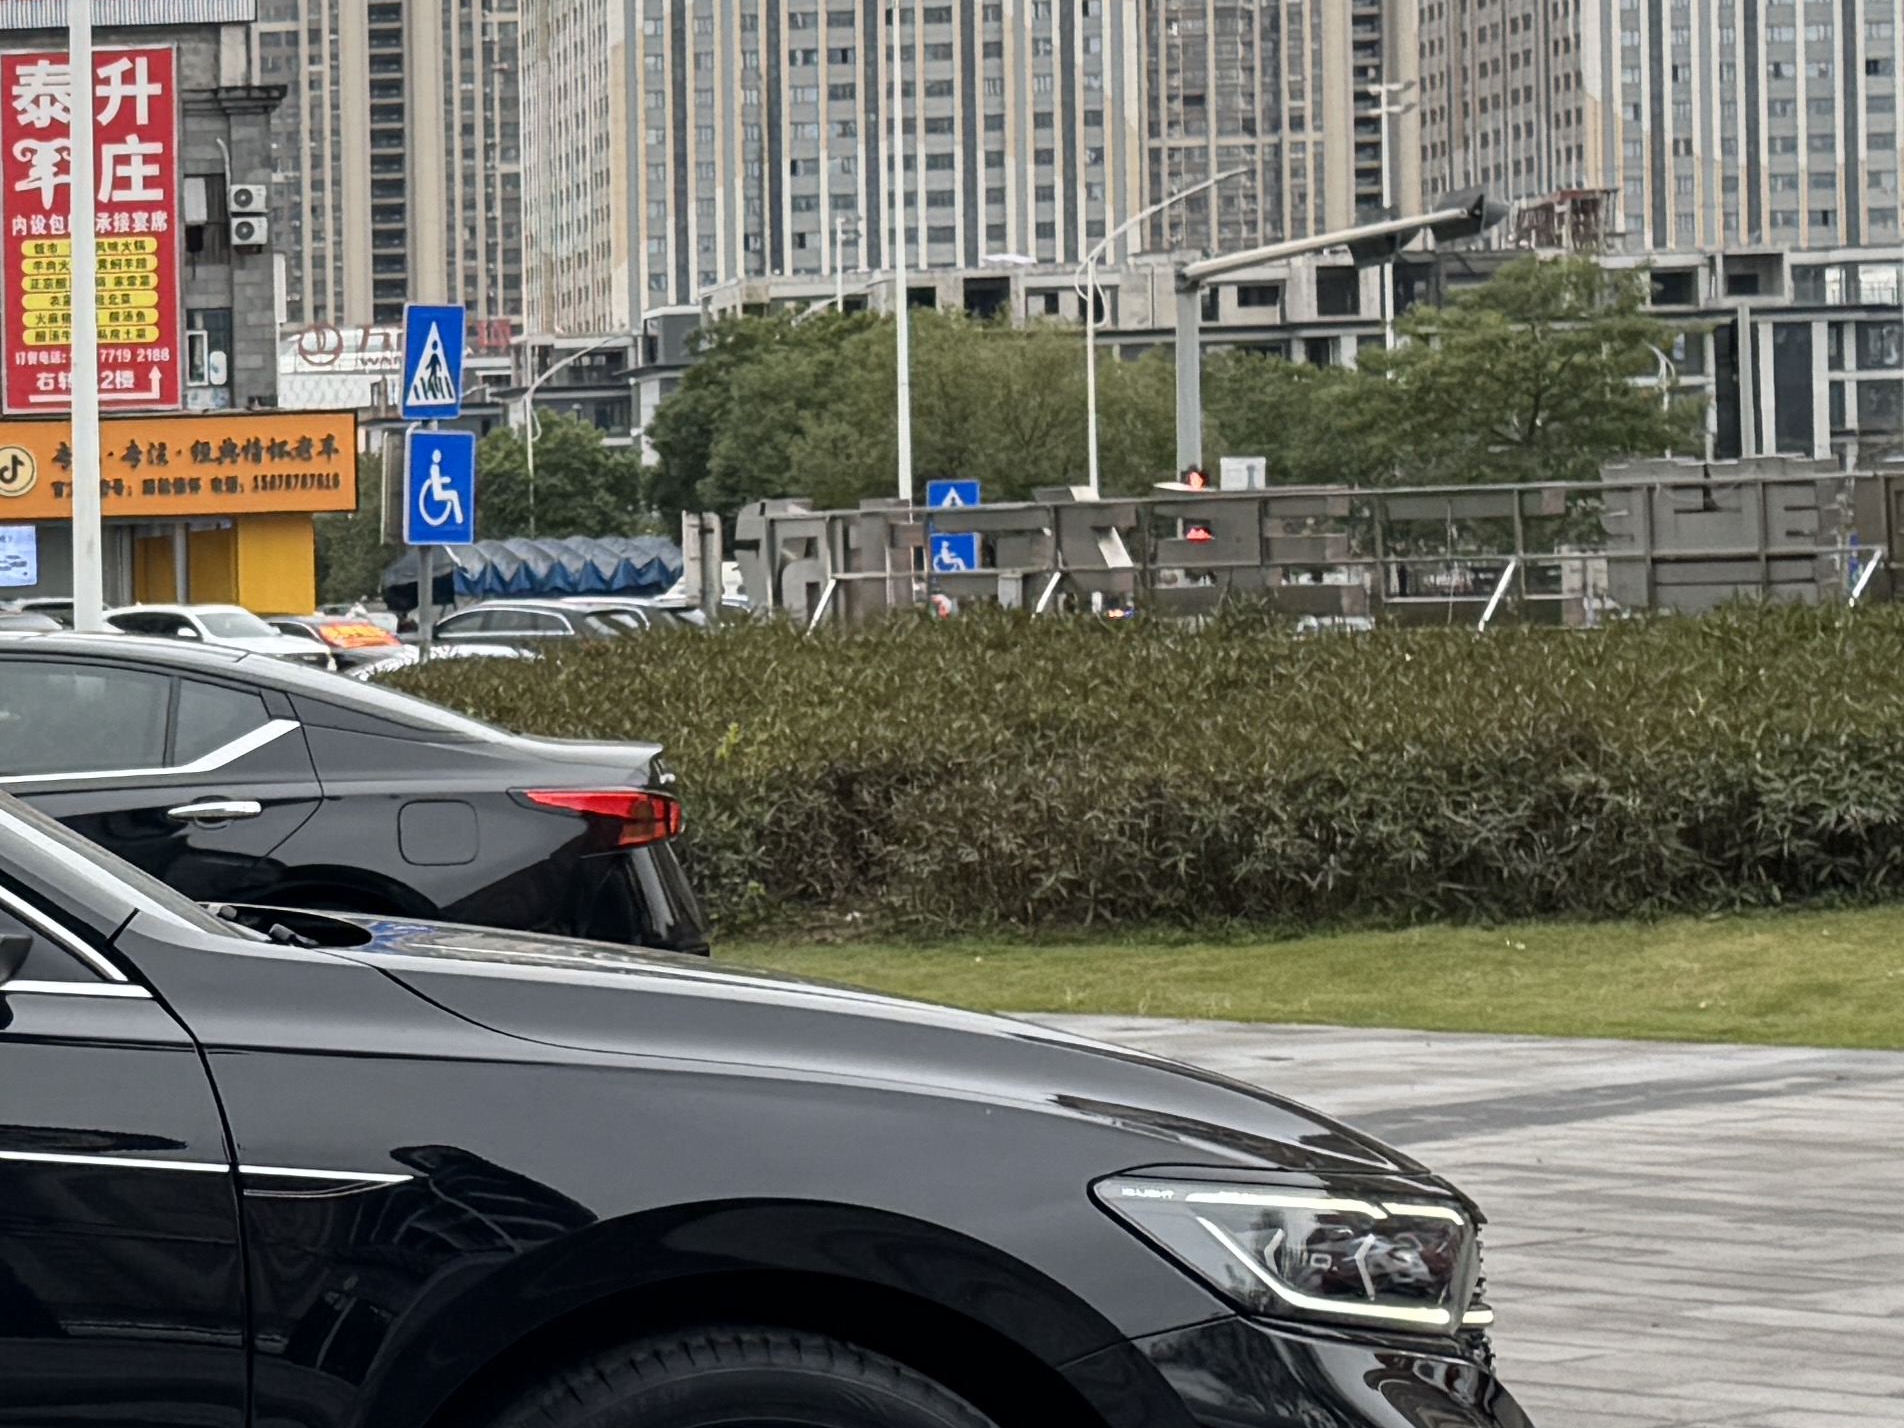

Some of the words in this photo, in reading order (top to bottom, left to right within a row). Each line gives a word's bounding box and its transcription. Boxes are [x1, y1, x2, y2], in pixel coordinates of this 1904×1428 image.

[11, 56, 162, 129] 泰升
[12, 213, 71, 236] 内设包
[36, 369, 135, 391] 右转2楼
